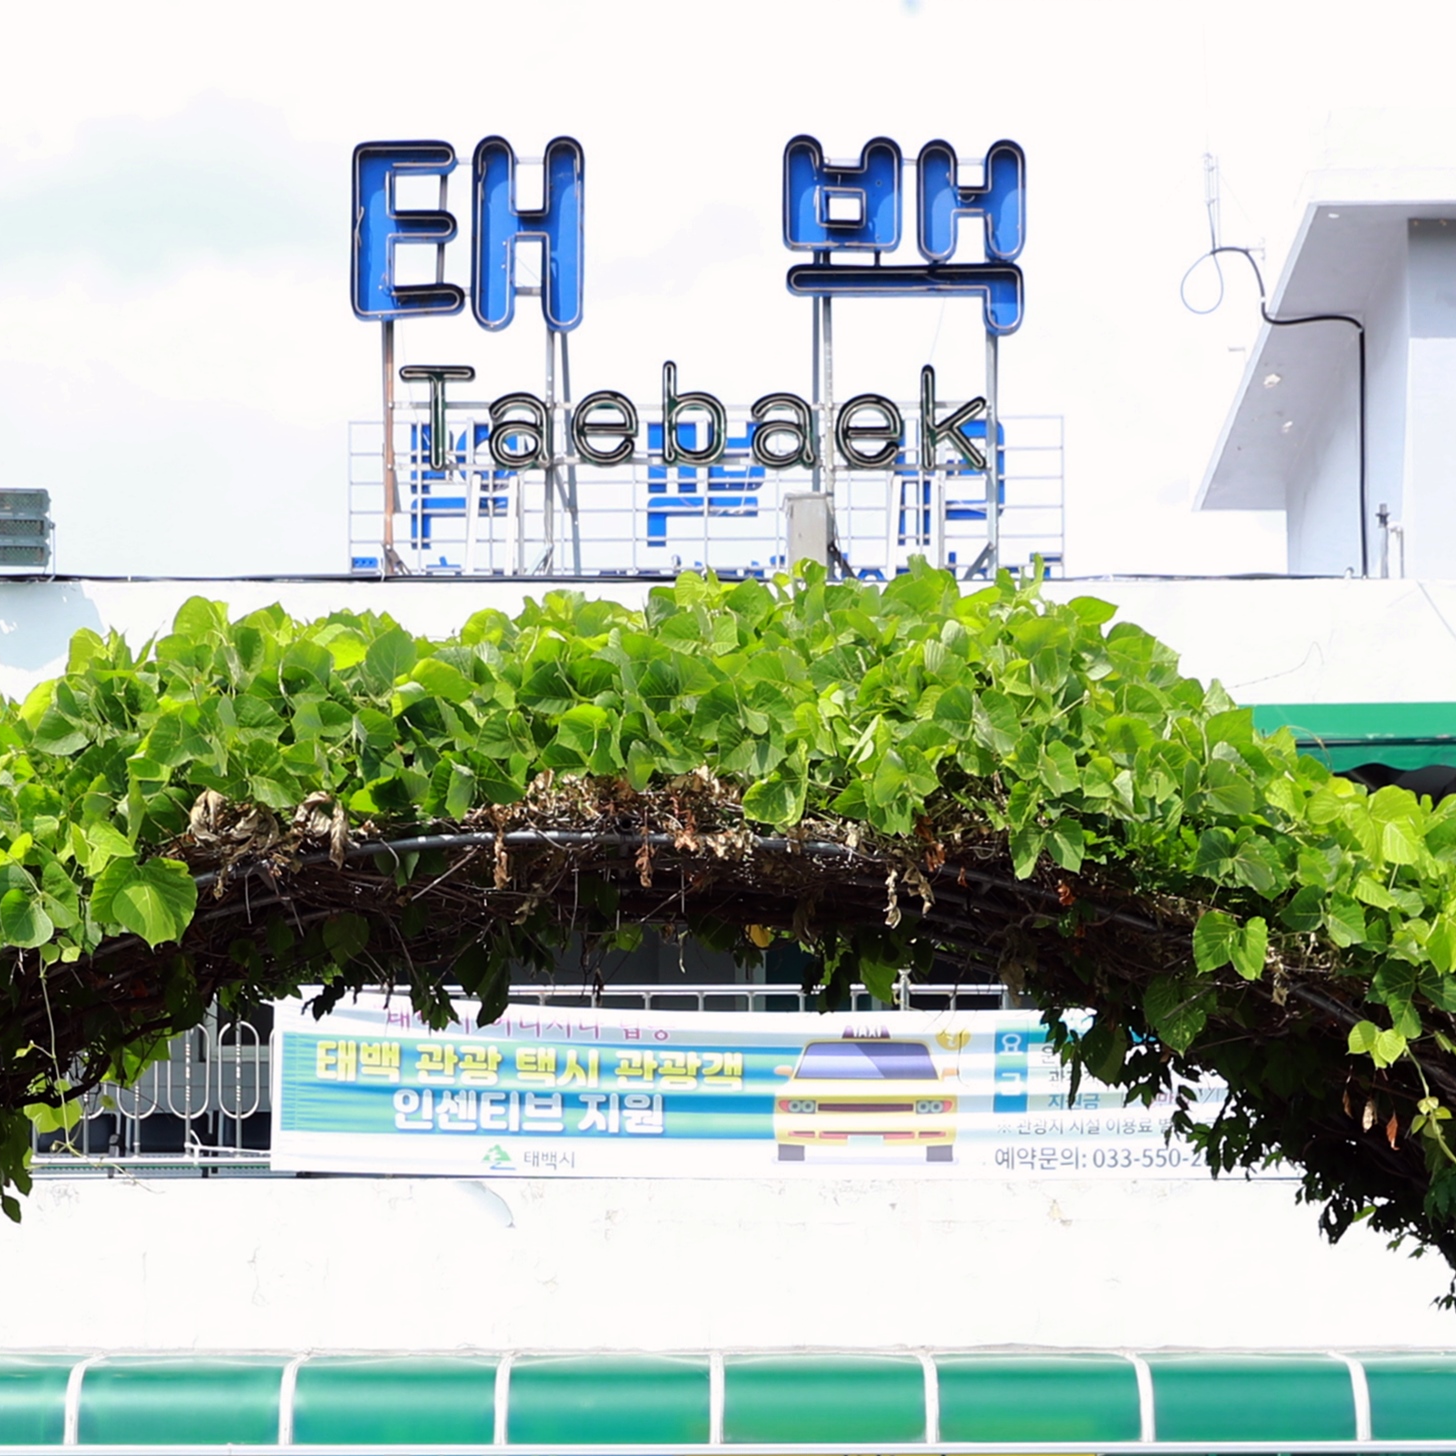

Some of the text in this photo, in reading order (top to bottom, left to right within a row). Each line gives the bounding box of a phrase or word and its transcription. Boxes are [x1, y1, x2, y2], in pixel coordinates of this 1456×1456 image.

[399, 360, 988, 471] Taebaek
[316, 1040, 744, 1091] 태백 관광 택시 관광객
[392, 1089, 665, 1135] 인센티브 지원
[1070, 1117, 1101, 1135] 시설
[1106, 1117, 1153, 1135] 이용료
[523, 1151, 577, 1169] 태백시
[995, 1146, 1210, 1171] 예약문의: 033-550-2
